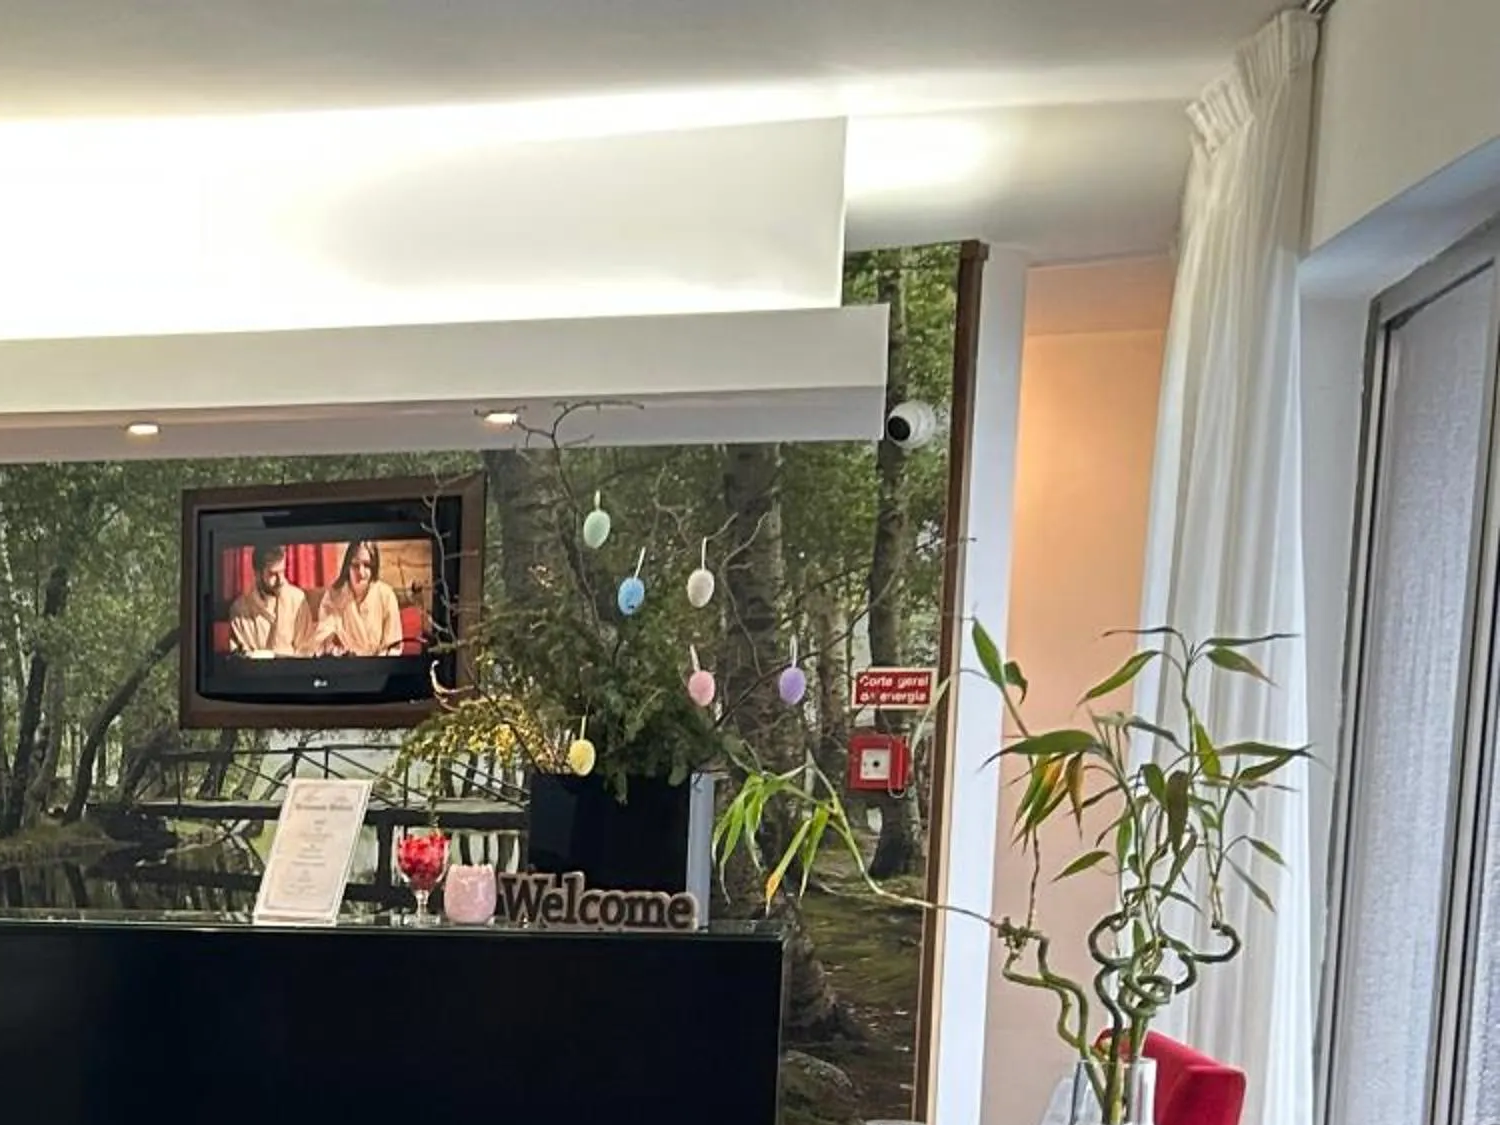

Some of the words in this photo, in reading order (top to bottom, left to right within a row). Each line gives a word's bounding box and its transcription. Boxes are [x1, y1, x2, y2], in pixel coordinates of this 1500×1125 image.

[859, 675, 893, 687] Corte
[898, 675, 928, 689] geral
[880, 690, 926, 704] energia
[500, 873, 696, 930] Welcome
